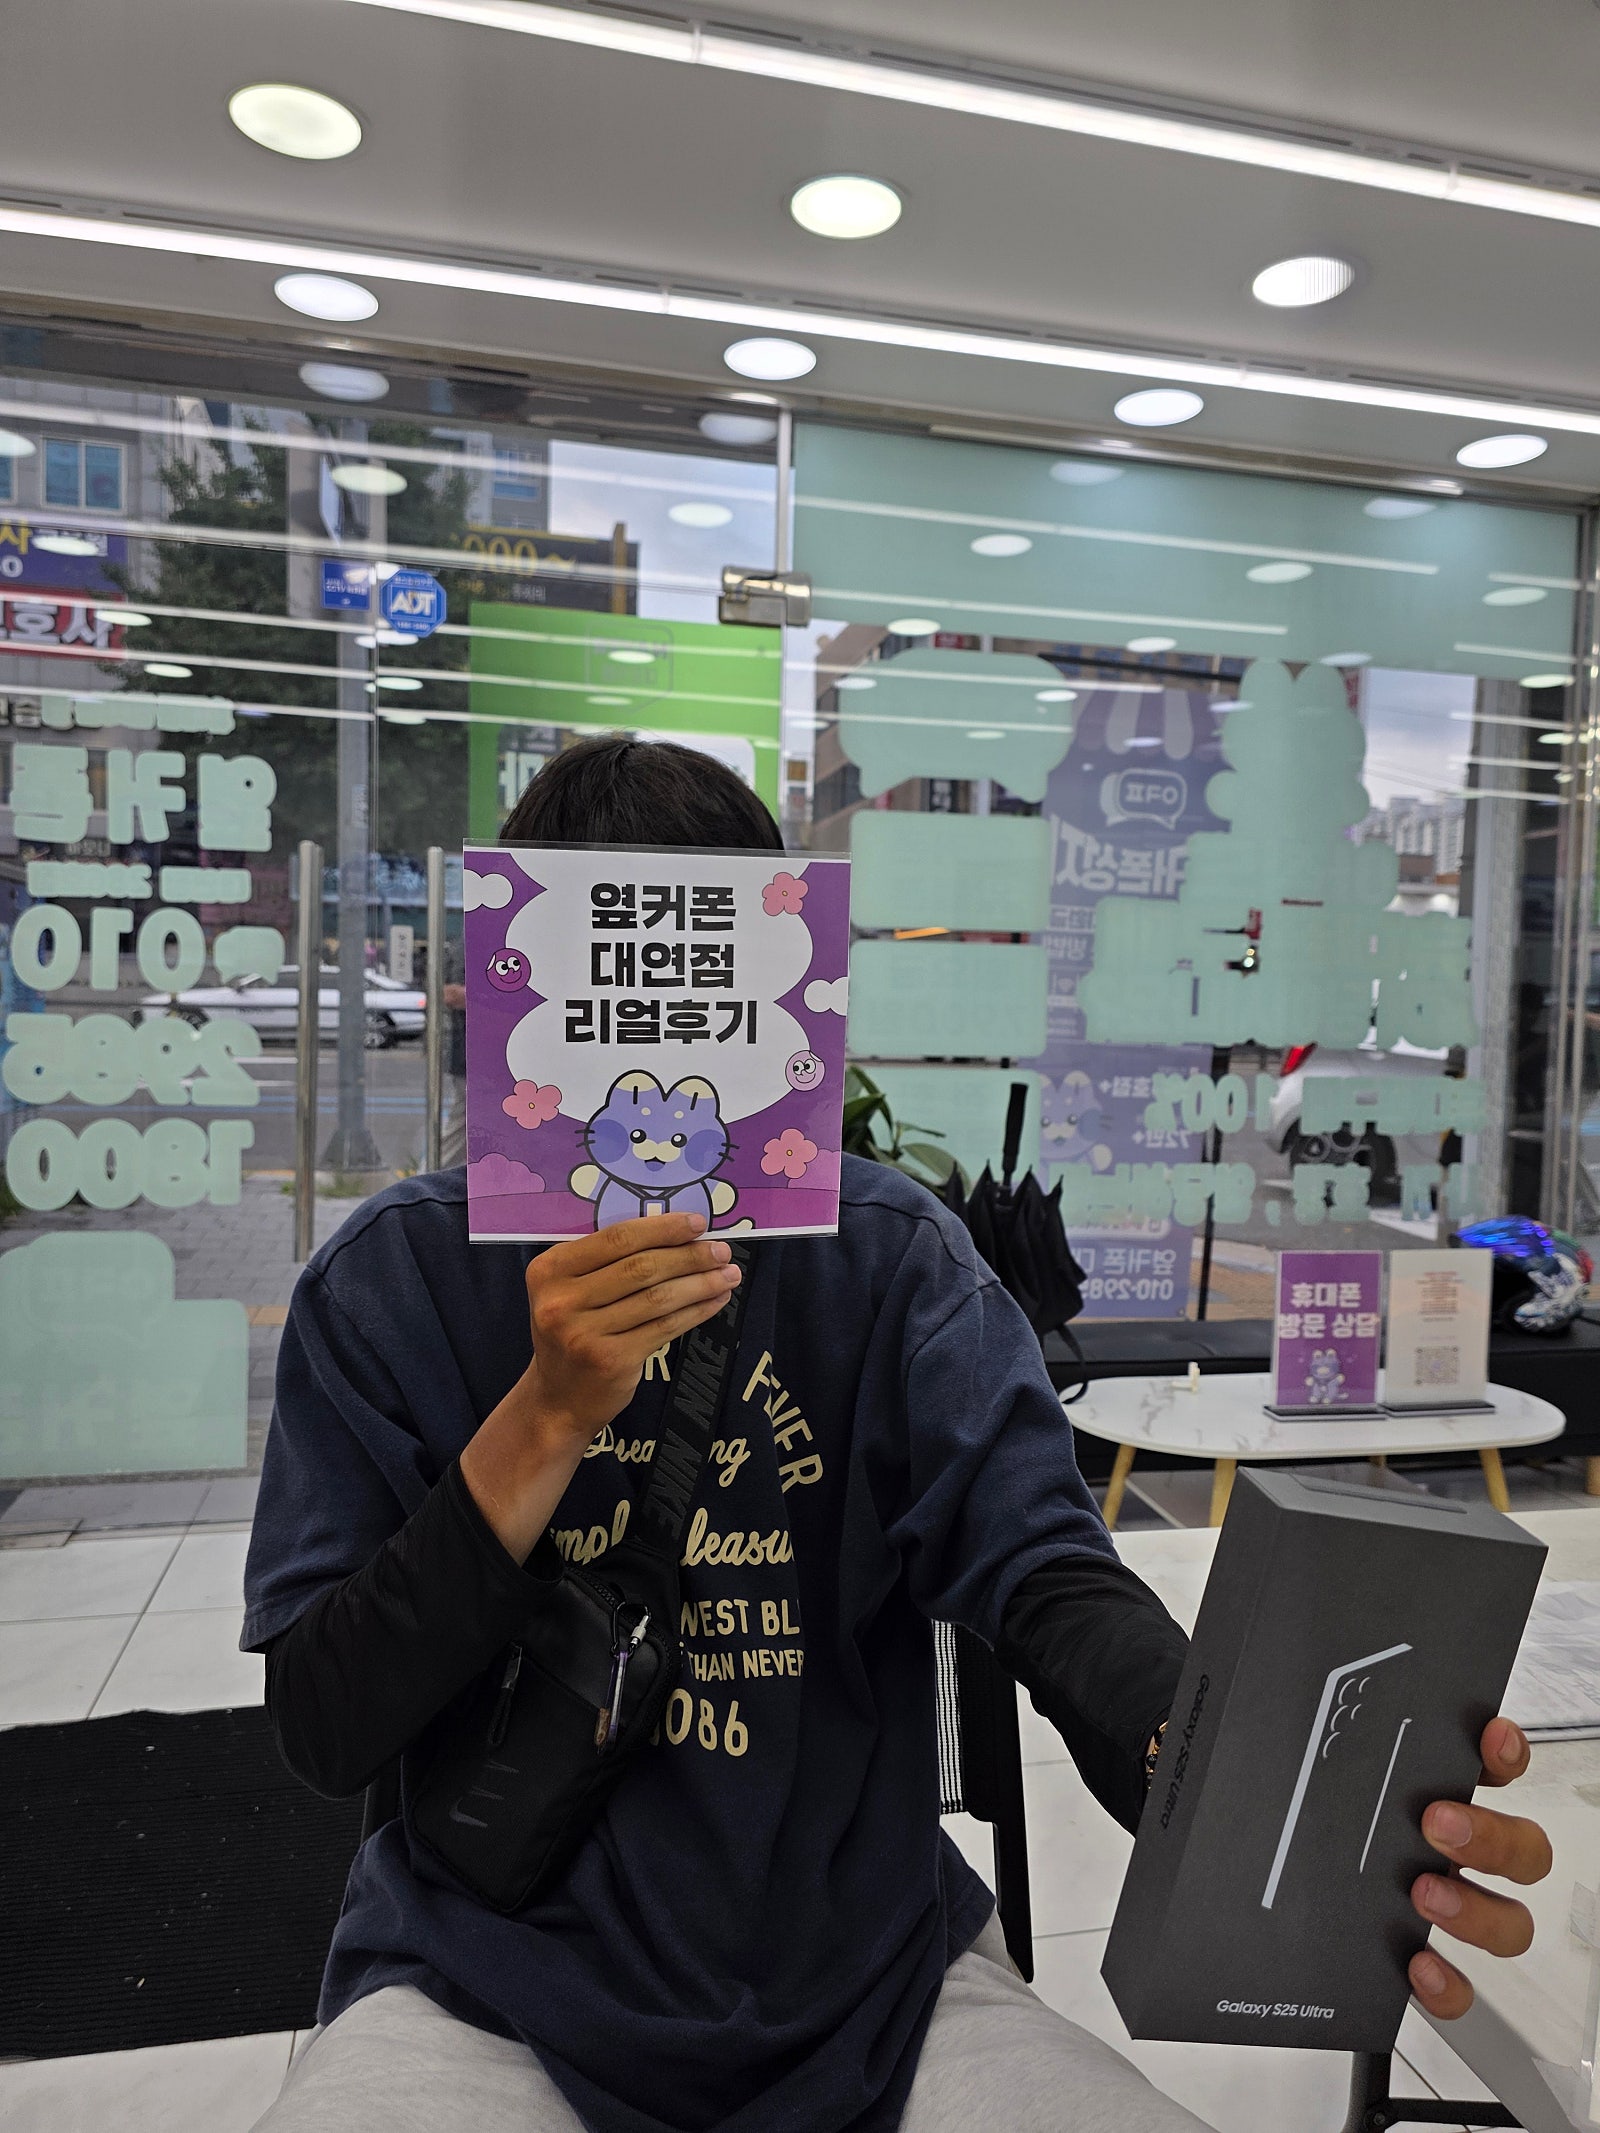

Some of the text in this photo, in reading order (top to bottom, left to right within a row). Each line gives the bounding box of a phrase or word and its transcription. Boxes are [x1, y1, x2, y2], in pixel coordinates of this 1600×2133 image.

[0, 601, 114, 649] 호사
[590, 882, 736, 931] 옆커폰
[591, 942, 734, 989] 대연점
[565, 999, 757, 1045] 리얼후기
[1290, 1282, 1362, 1308] 휴대폰
[1279, 1313, 1380, 1340] 방문 상담
[584, 1423, 752, 1489] Dreang
[681, 1598, 800, 1637] NEST BL
[650, 1688, 749, 1758] 086
[1183, 1674, 1210, 1748] Galaxy
[1216, 1999, 1335, 2019] Galaxy S25 Ultra
